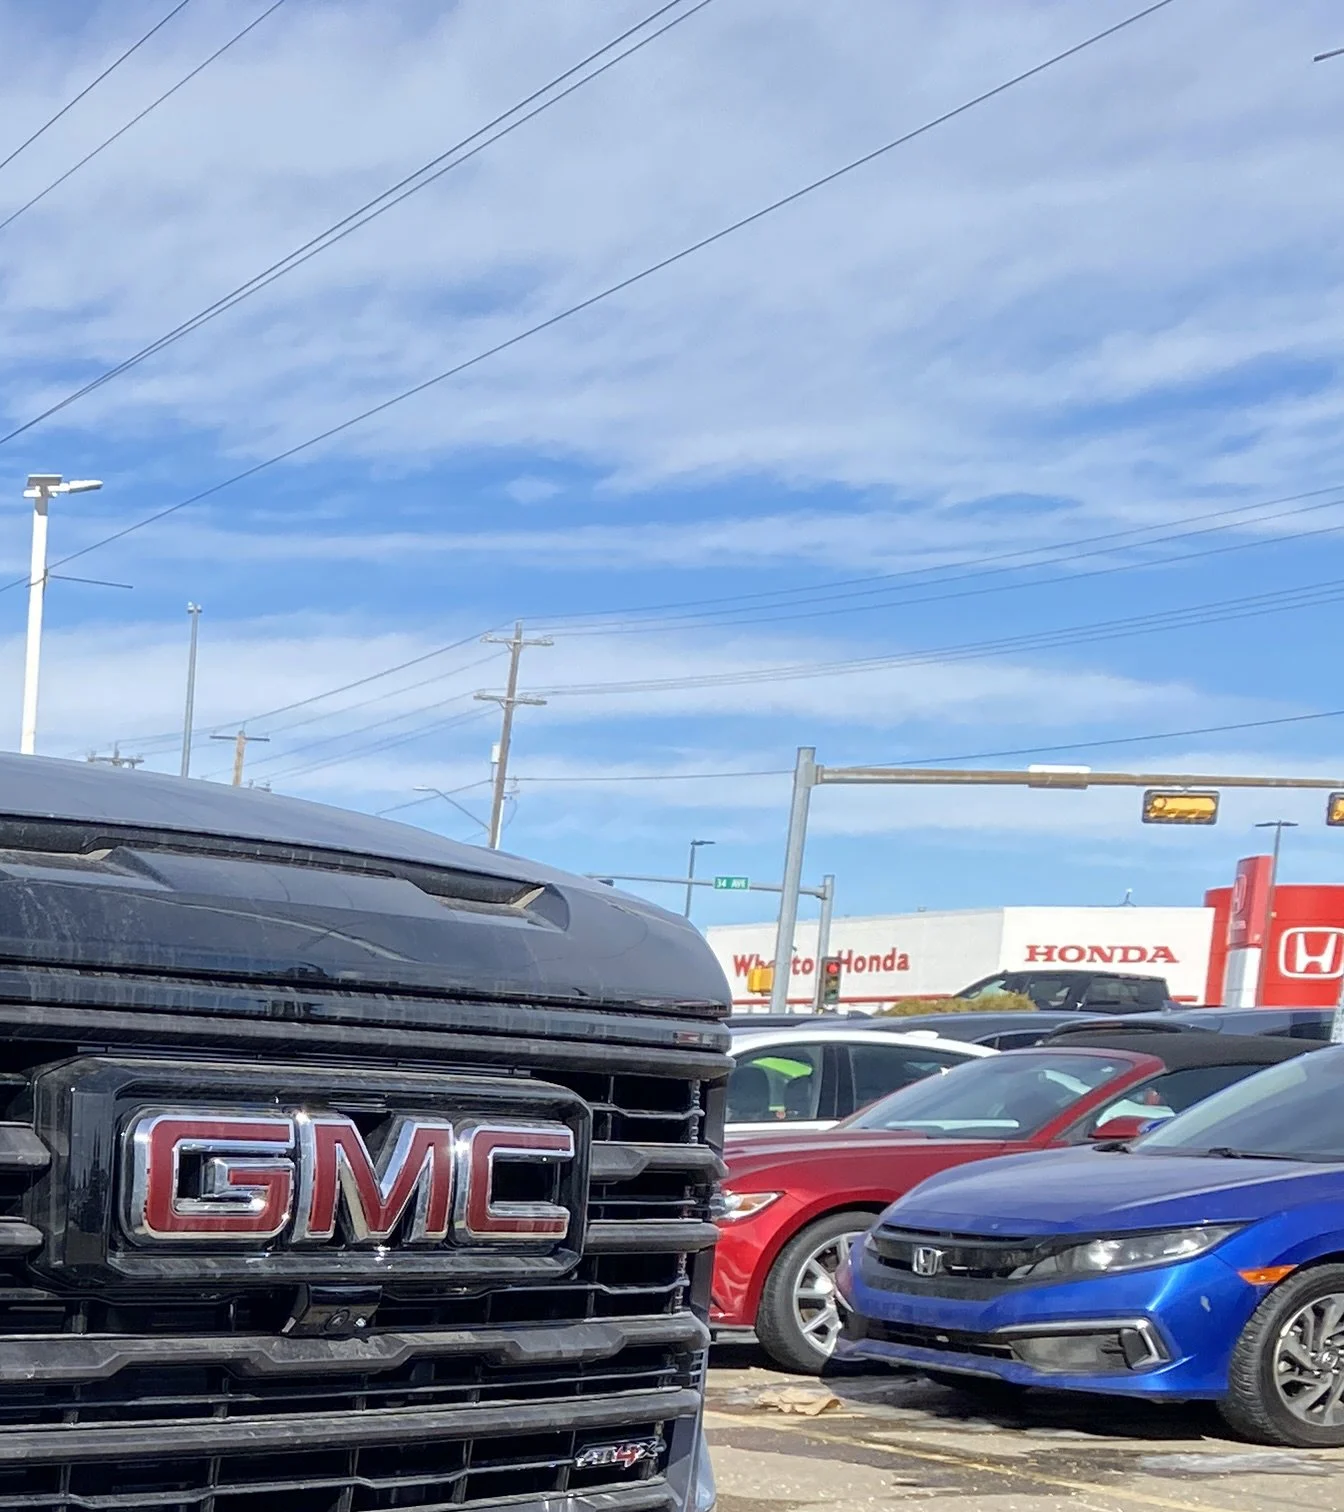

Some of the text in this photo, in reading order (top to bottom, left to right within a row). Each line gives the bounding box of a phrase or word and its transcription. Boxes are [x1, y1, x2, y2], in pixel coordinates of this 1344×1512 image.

[837, 946, 910, 975] Honda
[1024, 944, 1180, 964] HONDA
[132, 1111, 576, 1244] GMC
